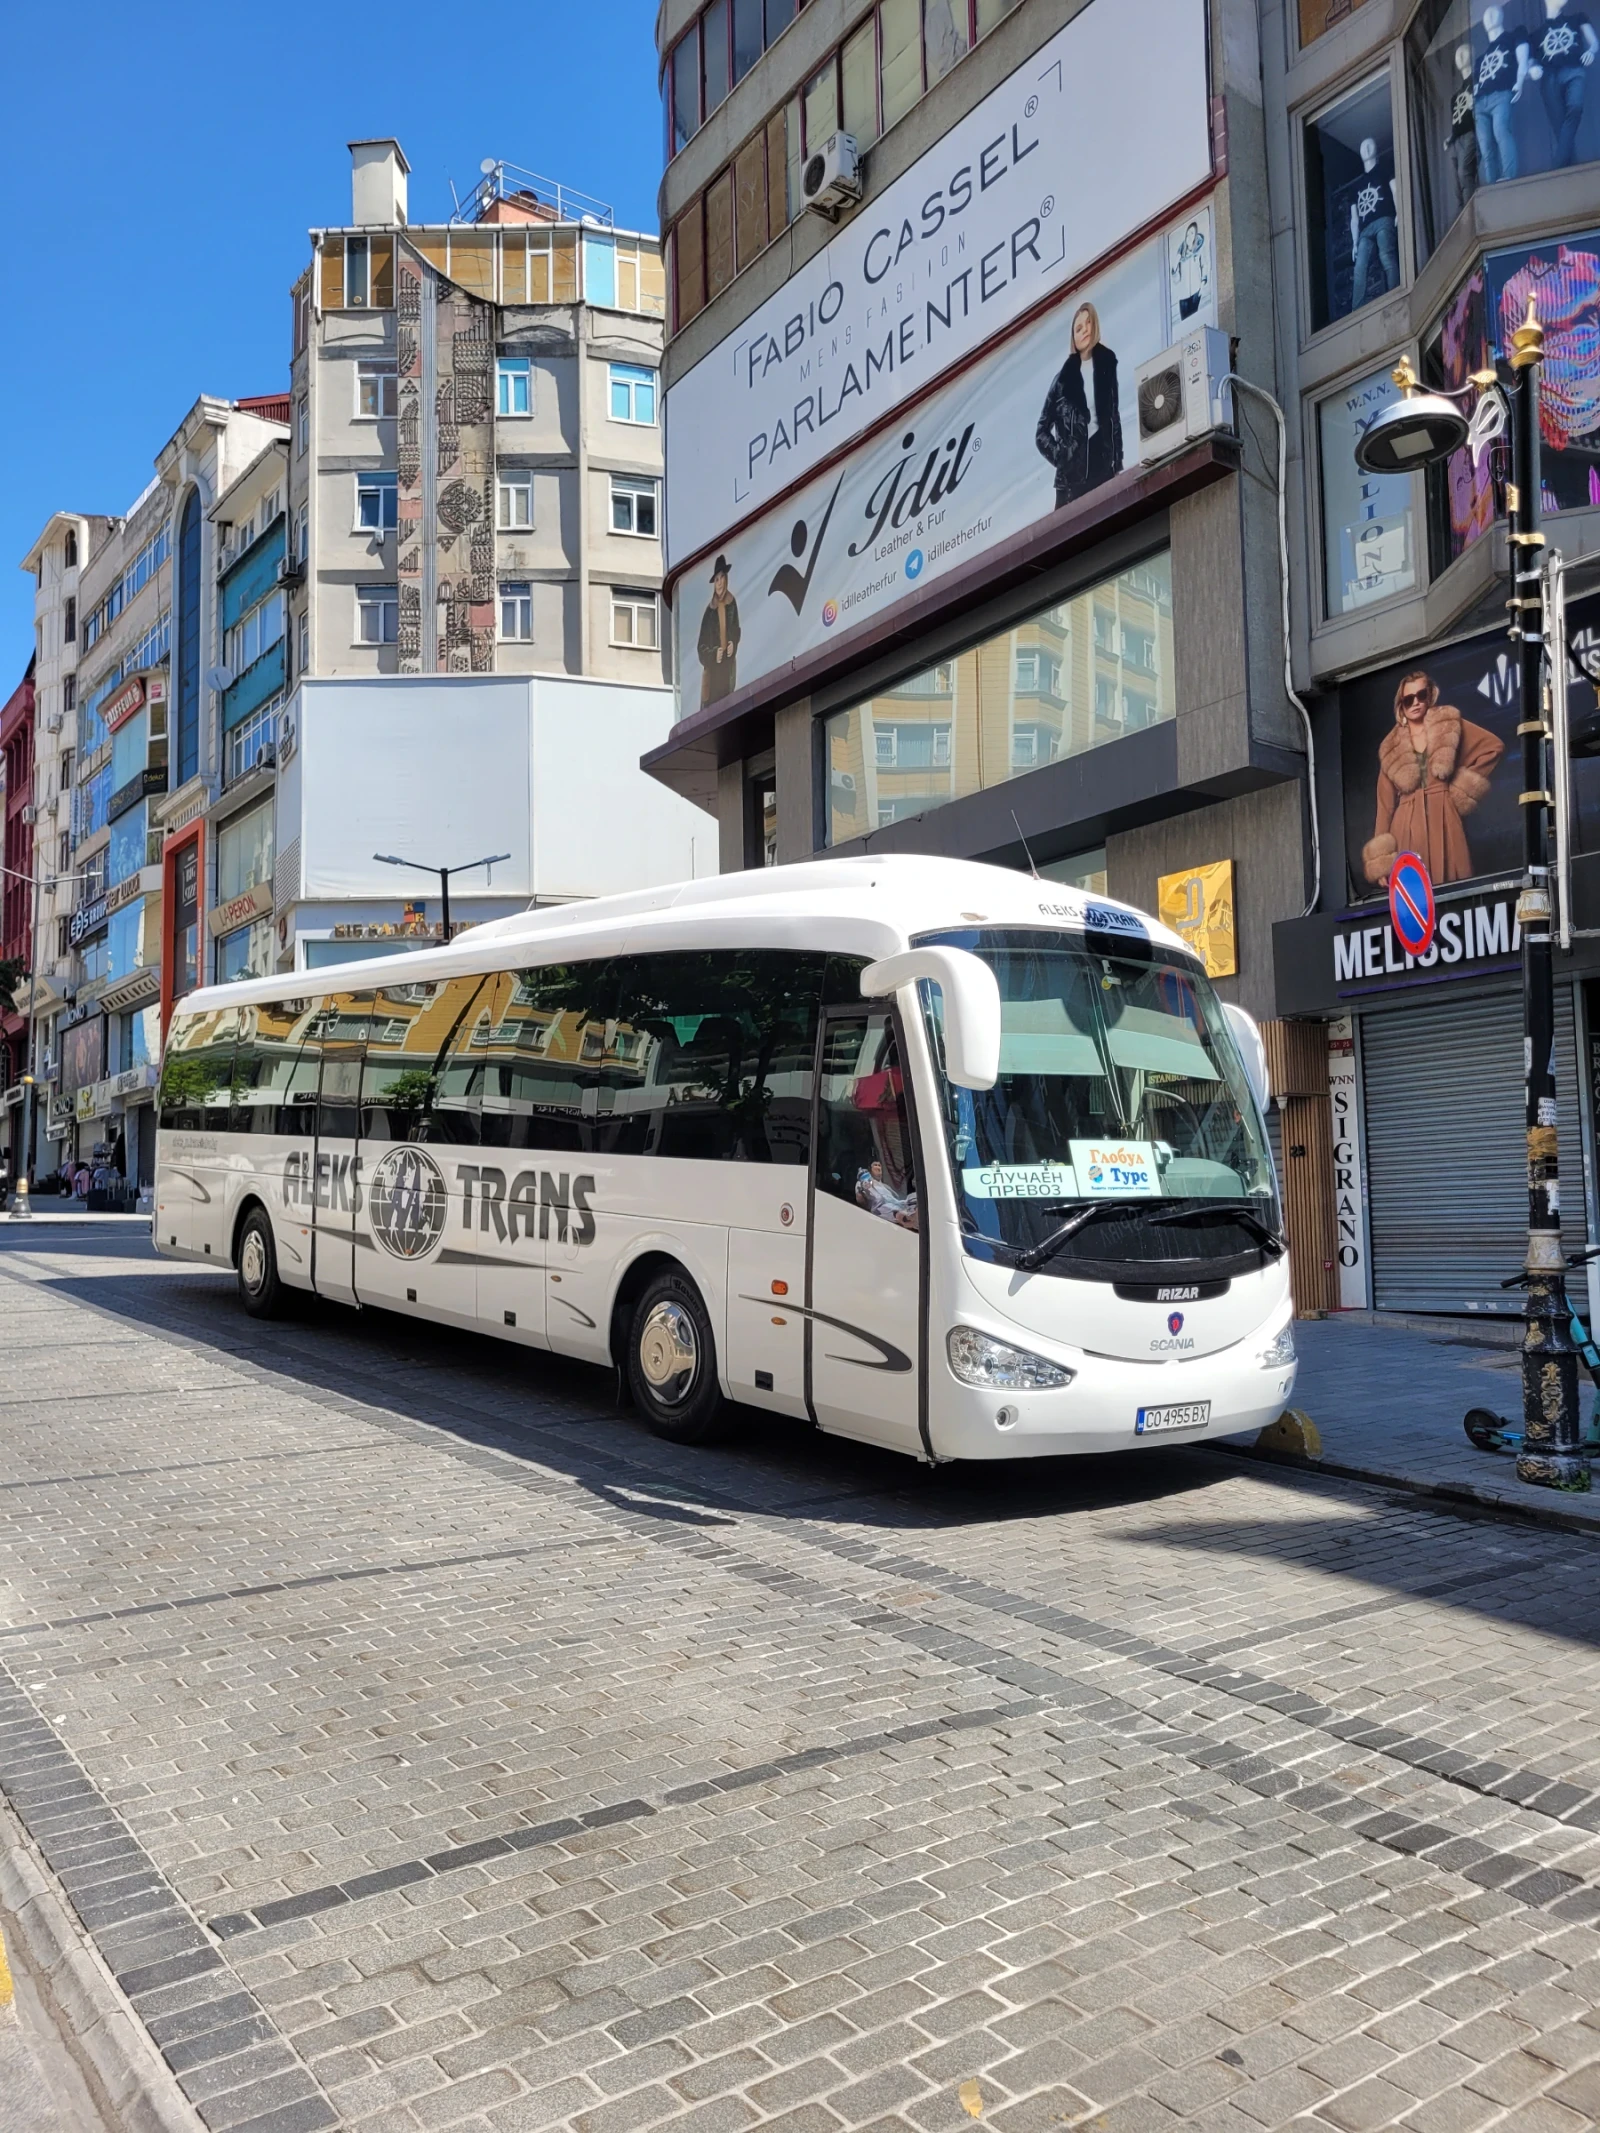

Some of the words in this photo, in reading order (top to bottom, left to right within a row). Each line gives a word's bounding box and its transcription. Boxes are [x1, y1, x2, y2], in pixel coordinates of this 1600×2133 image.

[800, 326, 852, 383] MENS
[866, 231, 966, 329] FASION
[749, 281, 844, 389] FABIO
[874, 529, 914, 562] Leather
[916, 521, 925, 537] &
[927, 508, 947, 530] Fur
[927, 515, 993, 563] idilleatherfur
[841, 570, 898, 611] idilleatherfur
[1038, 903, 1079, 917] ALEKS
[1102, 912, 1145, 928] TRANS
[1333, 901, 1522, 982] MELSIM
[1328, 1074, 1355, 1086] WNN
[1089, 1147, 1145, 1167] Глобул
[989, 1185, 1061, 1197] ПРЕВОЗ
[1110, 1167, 1149, 1185] Турс
[1333, 1091, 1359, 1268] SIGRANO
[282, 1151, 364, 1214] ALEKS
[456, 1164, 597, 1248] TRANS
[1157, 1287, 1199, 1301] IRIZAR
[1149, 1338, 1195, 1351] SCANIA
[1146, 1410, 1162, 1428] CO
[1163, 1407, 1190, 1425] 4955
[1192, 1405, 1207, 1422] BX
